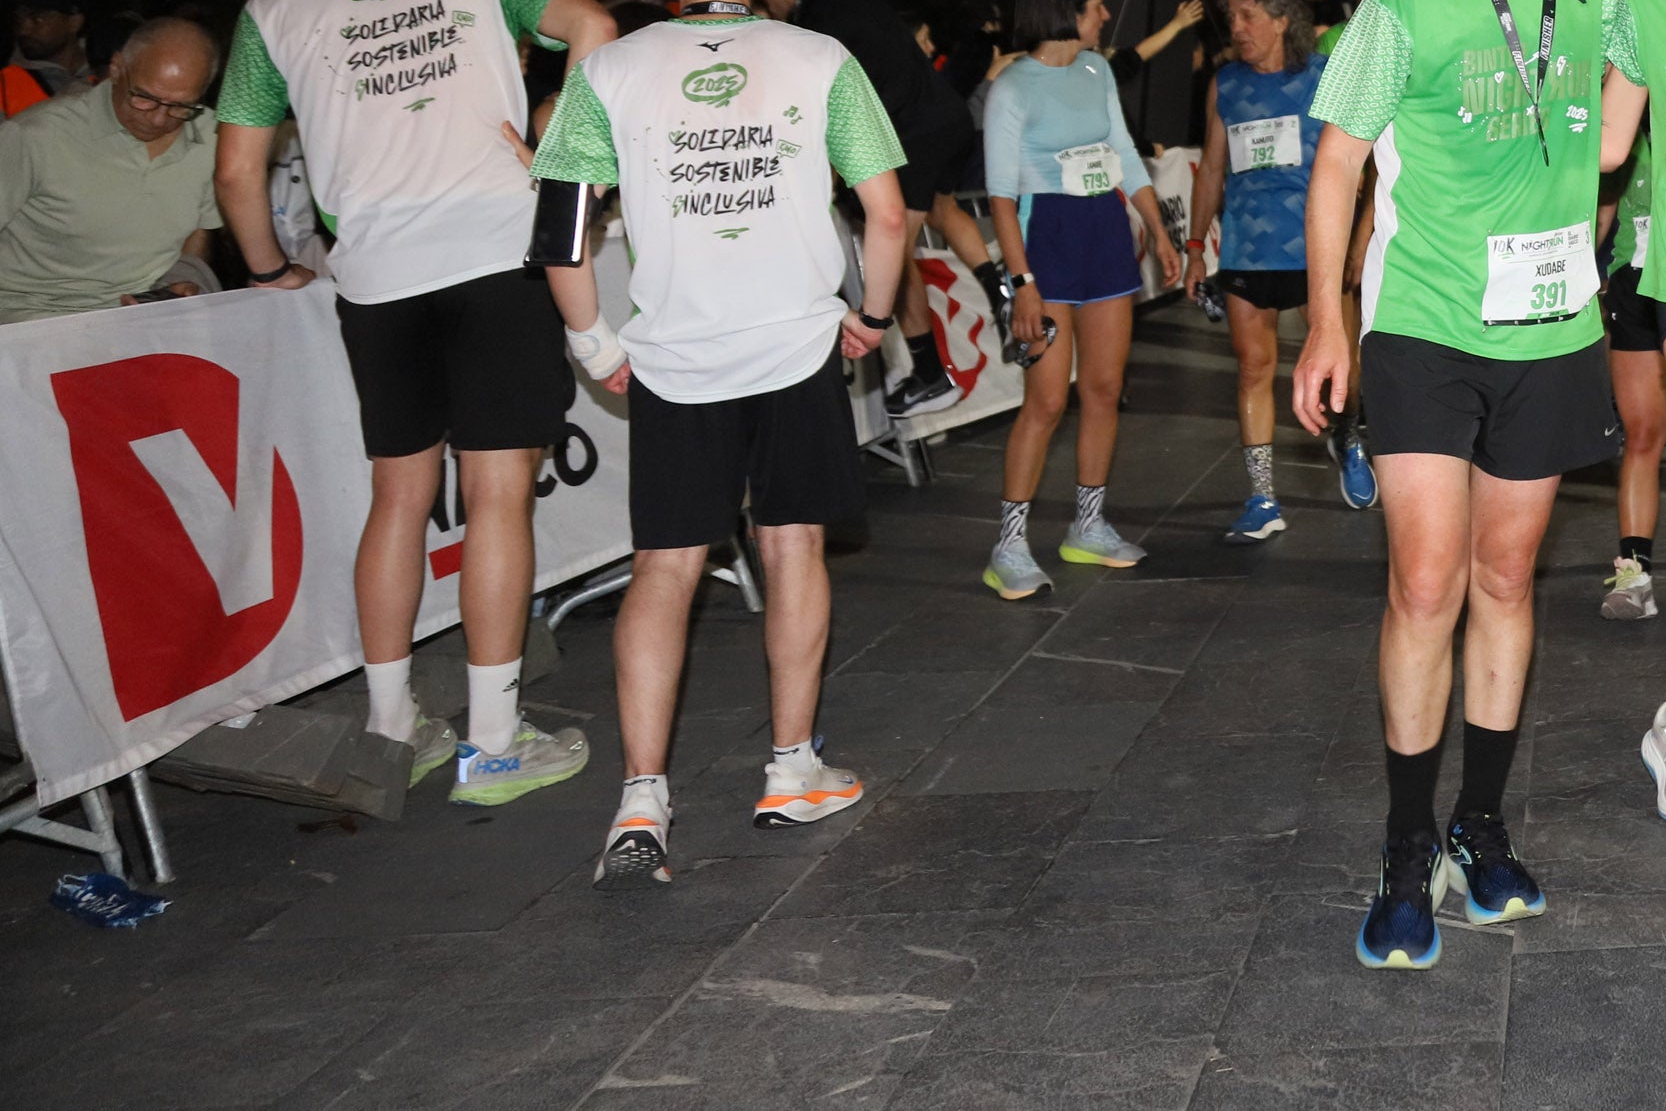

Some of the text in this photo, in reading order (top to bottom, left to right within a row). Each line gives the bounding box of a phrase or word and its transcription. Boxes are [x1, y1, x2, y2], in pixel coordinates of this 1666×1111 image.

[345, 0, 446, 46] SOLIDARIA
[347, 25, 462, 72] SOSTENIBLE
[1539, 15, 1554, 61] FINISHER
[363, 52, 457, 96] INCLUSIVA
[693, 74, 738, 94] 2025
[1565, 104, 1589, 121] 2025
[672, 124, 774, 154] SOLIDARIA
[1250, 145, 1276, 163] 792
[669, 156, 783, 184] SOSTENIBLE
[1081, 171, 1111, 190] F793
[682, 184, 776, 217] INCLUSIVA
[1635, 218, 1649, 230] 10K
[1493, 236, 1516, 255] 10K
[1535, 259, 1567, 278] XUDABE
[1529, 279, 1568, 310] 391
